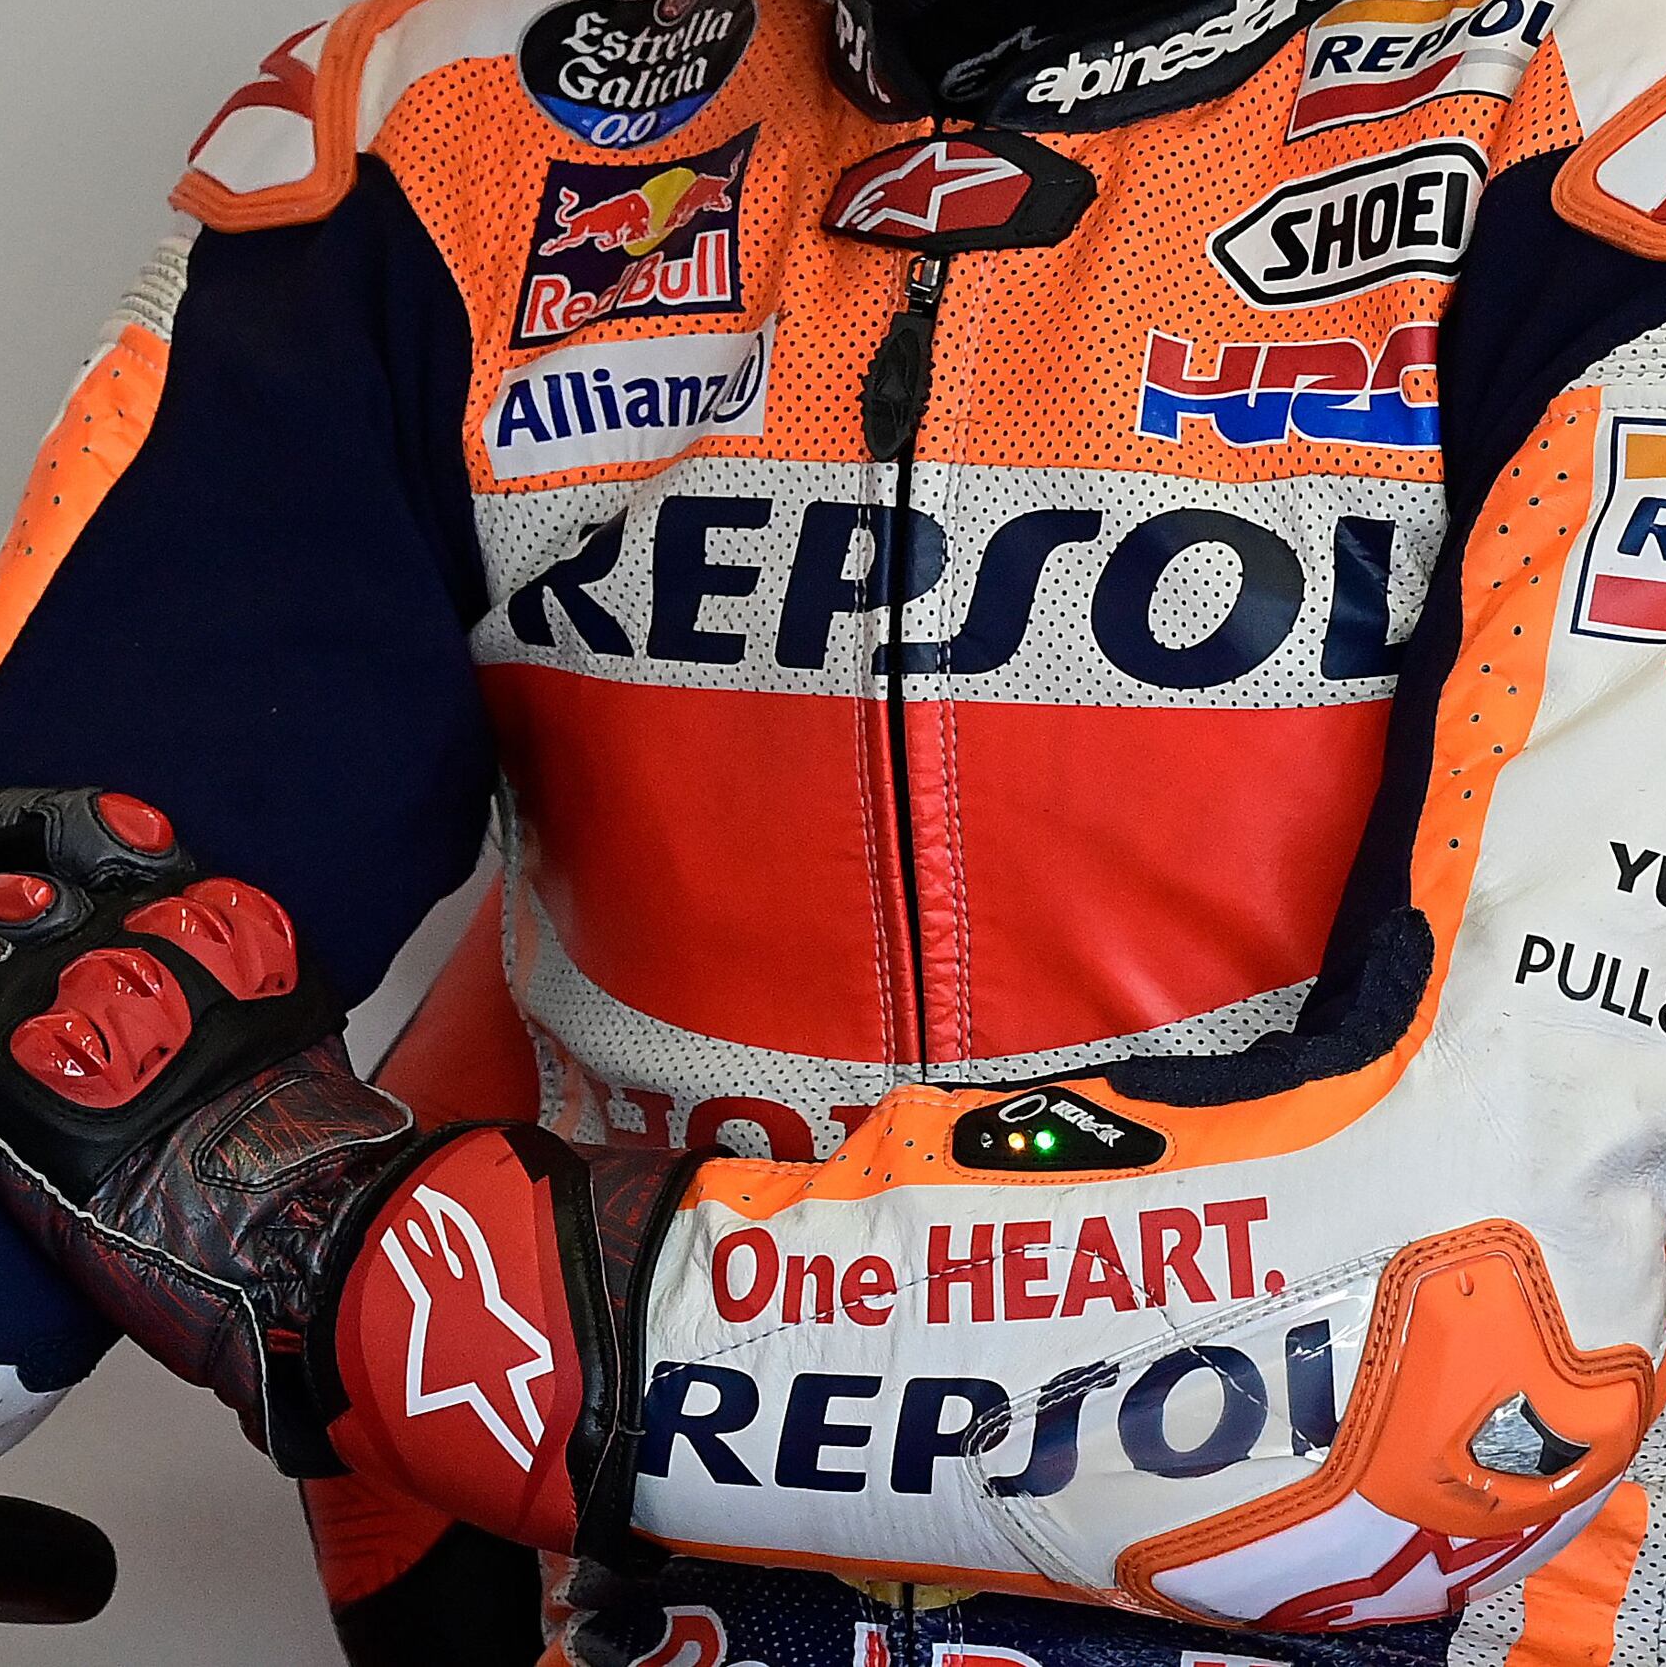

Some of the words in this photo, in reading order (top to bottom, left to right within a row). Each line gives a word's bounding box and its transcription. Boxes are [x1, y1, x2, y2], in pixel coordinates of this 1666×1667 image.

[558, 53, 708, 109] Galicia
[561, 8, 734, 66] Estrella
[1263, 171, 1469, 282] SHOEI
[522, 264, 636, 336] Red
[617, 231, 730, 308] Bull
[495, 368, 729, 449] Allianz
[507, 495, 1415, 690] REPSOL
[711, 1227, 897, 1327] One
[925, 1196, 1287, 1326] HEART.
[637, 1319, 1341, 1500] REPSOL
